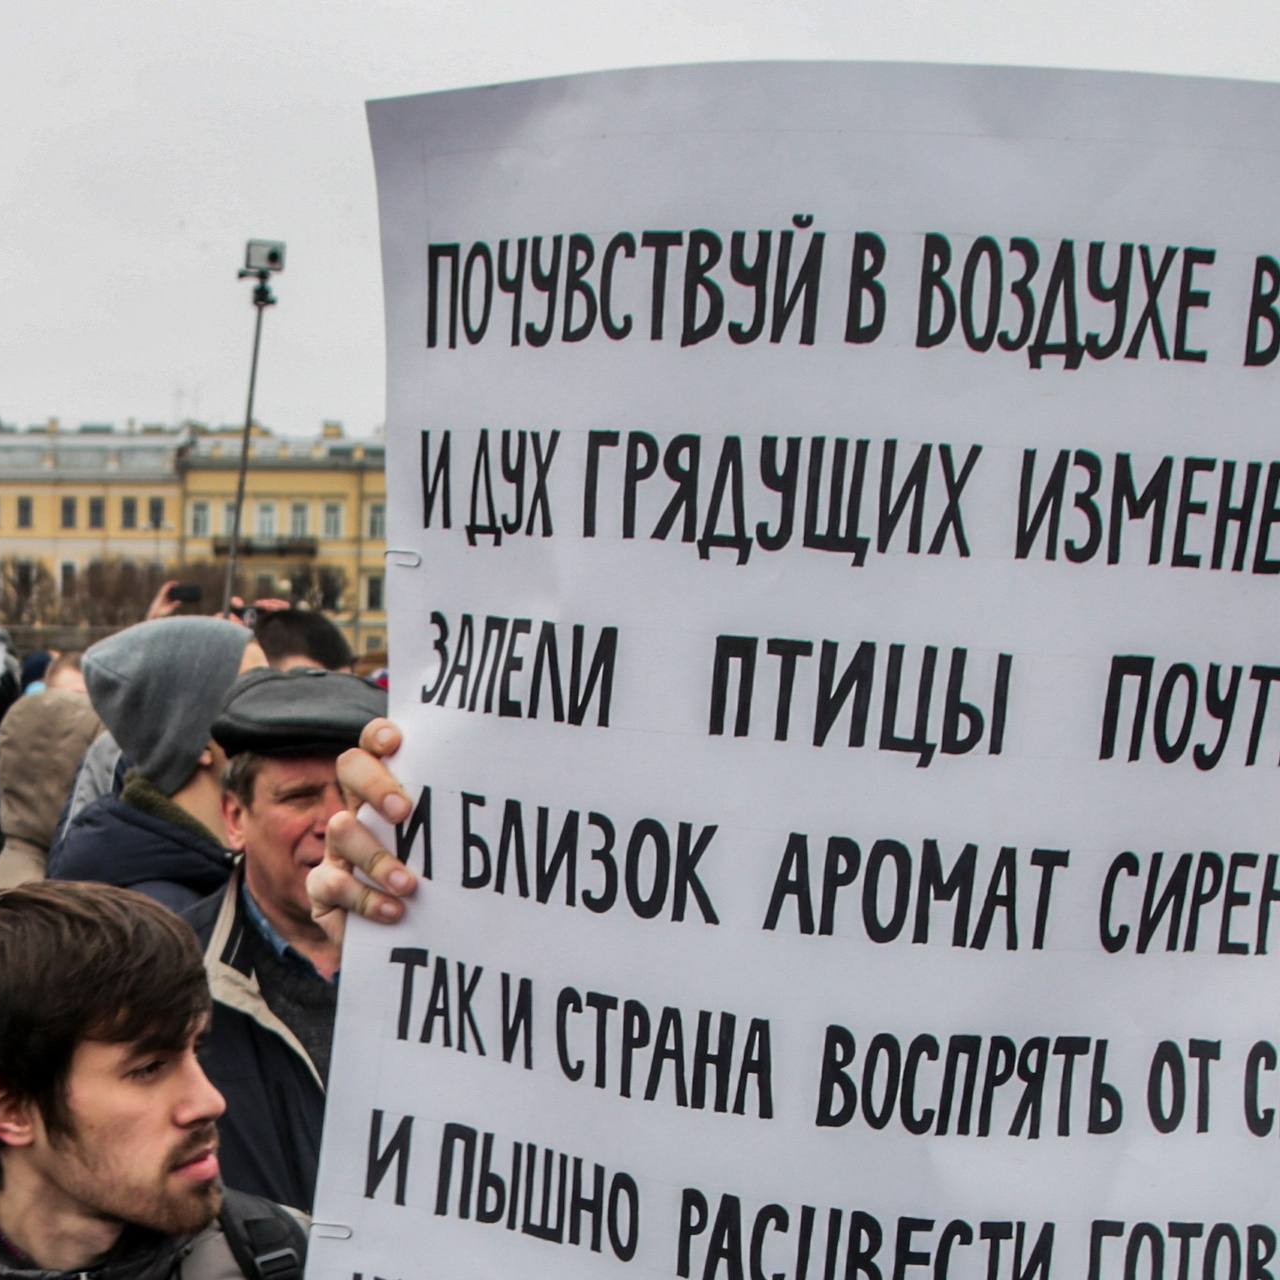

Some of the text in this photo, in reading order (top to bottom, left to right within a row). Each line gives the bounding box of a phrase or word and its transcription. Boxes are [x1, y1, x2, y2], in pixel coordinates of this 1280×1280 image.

[427, 214, 1280, 369] ПОЧУВСТВУЙ В ВОЗДУХЕ В
[422, 429, 1280, 574] И ДУХ ГРЯДУЩИХ ИЗМЕНЕ
[422, 612, 617, 727] ЗАПЕЛИ
[709, 635, 1012, 767] ПТИЦЫ
[395, 785, 432, 882] И
[461, 792, 719, 925] БЛИЗОК
[763, 833, 1069, 950] АРОМАТ
[390, 948, 486, 1056] ТАК
[501, 973, 532, 1070] И
[557, 987, 773, 1119] СТРАНА
[816, 1025, 1122, 1139] ВОСПРЯТЬ
[1148, 1039, 1220, 1133] ОТ
[365, 1109, 413, 1206] И
[435, 1123, 638, 1262] ПЫШНО
